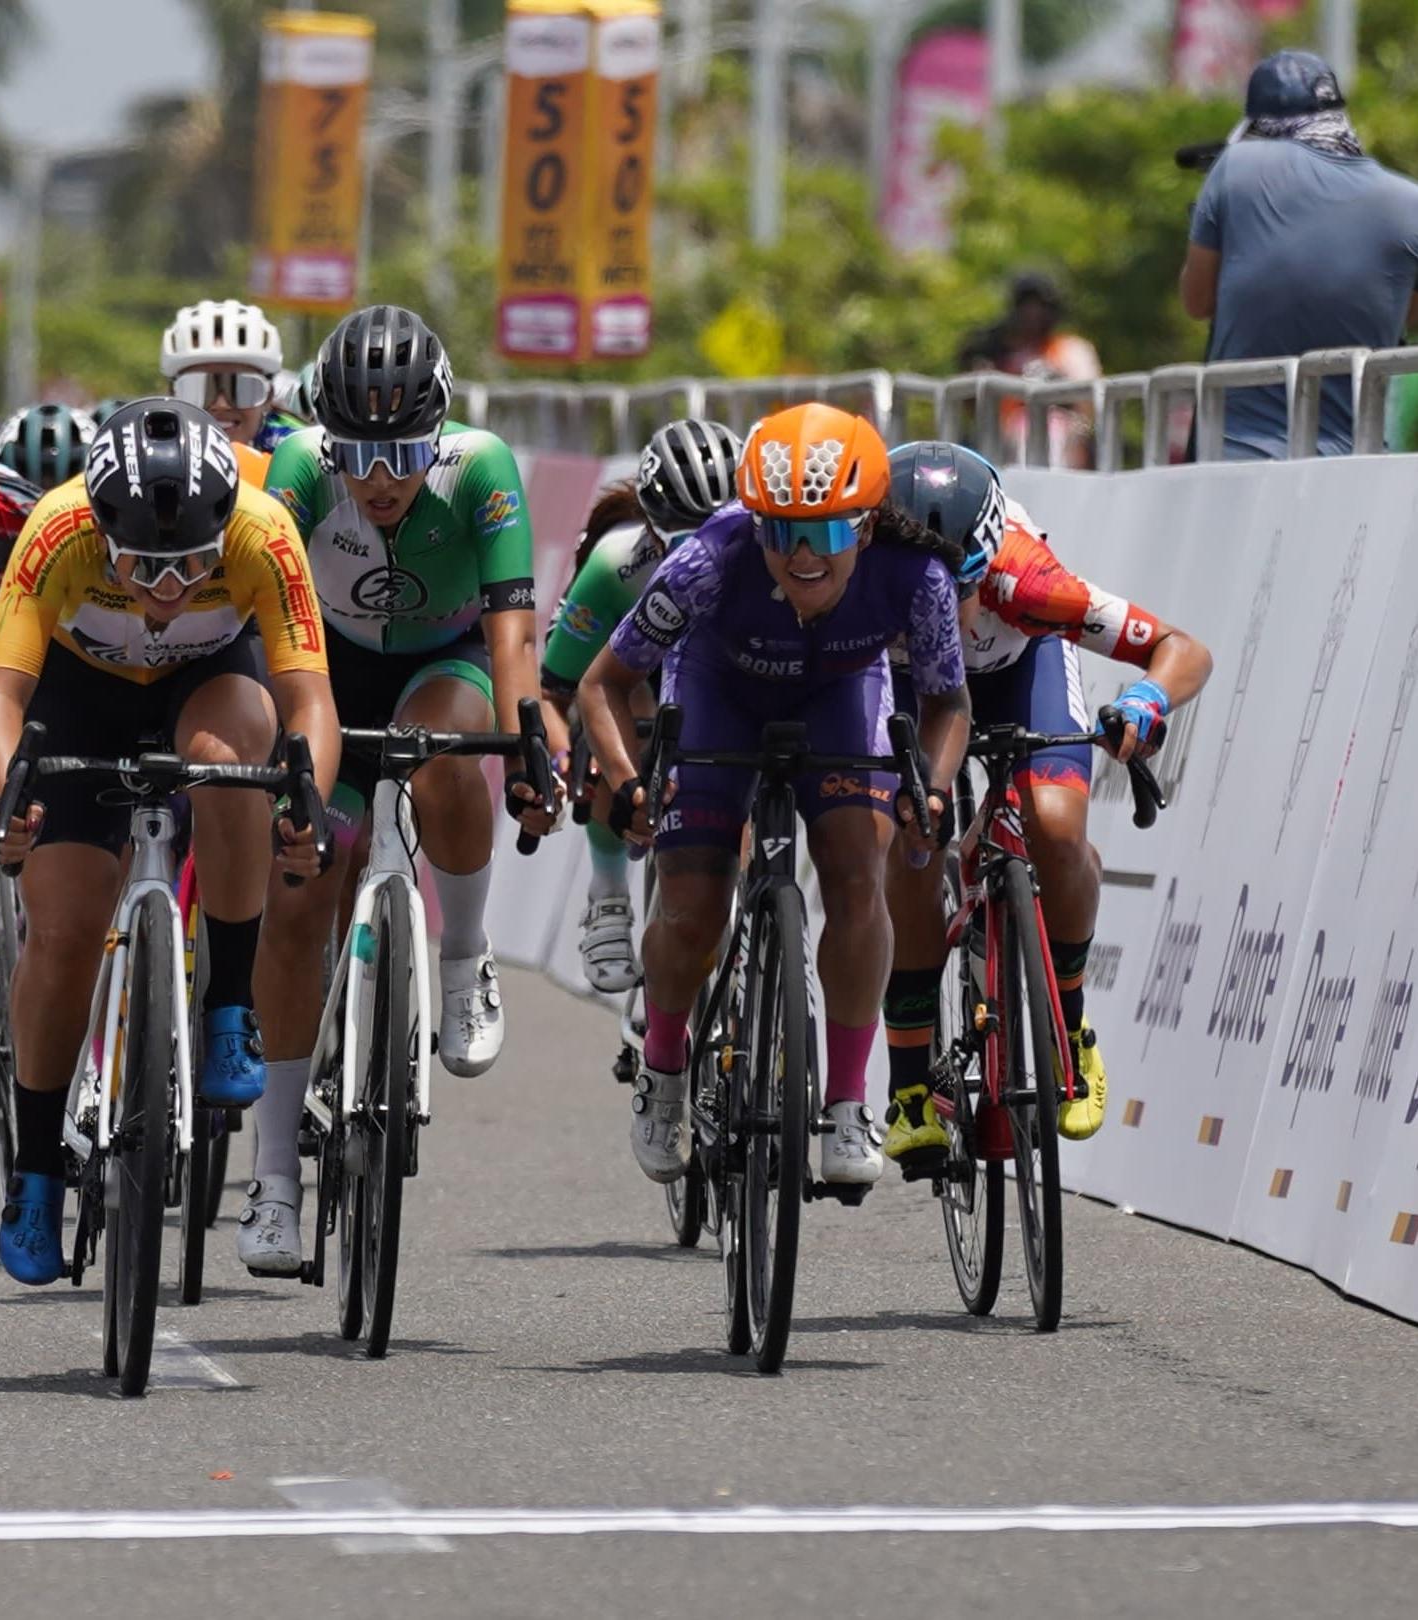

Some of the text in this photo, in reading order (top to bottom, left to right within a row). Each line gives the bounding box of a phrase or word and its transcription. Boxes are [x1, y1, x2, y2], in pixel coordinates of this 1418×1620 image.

[122, 422, 142, 498] TREK
[188, 421, 203, 496] TREK
[649, 595, 682, 625] VELO
[737, 652, 804, 676] BONE
[1207, 884, 1285, 1078] Deporte
[1281, 930, 1355, 1128] Deporte
